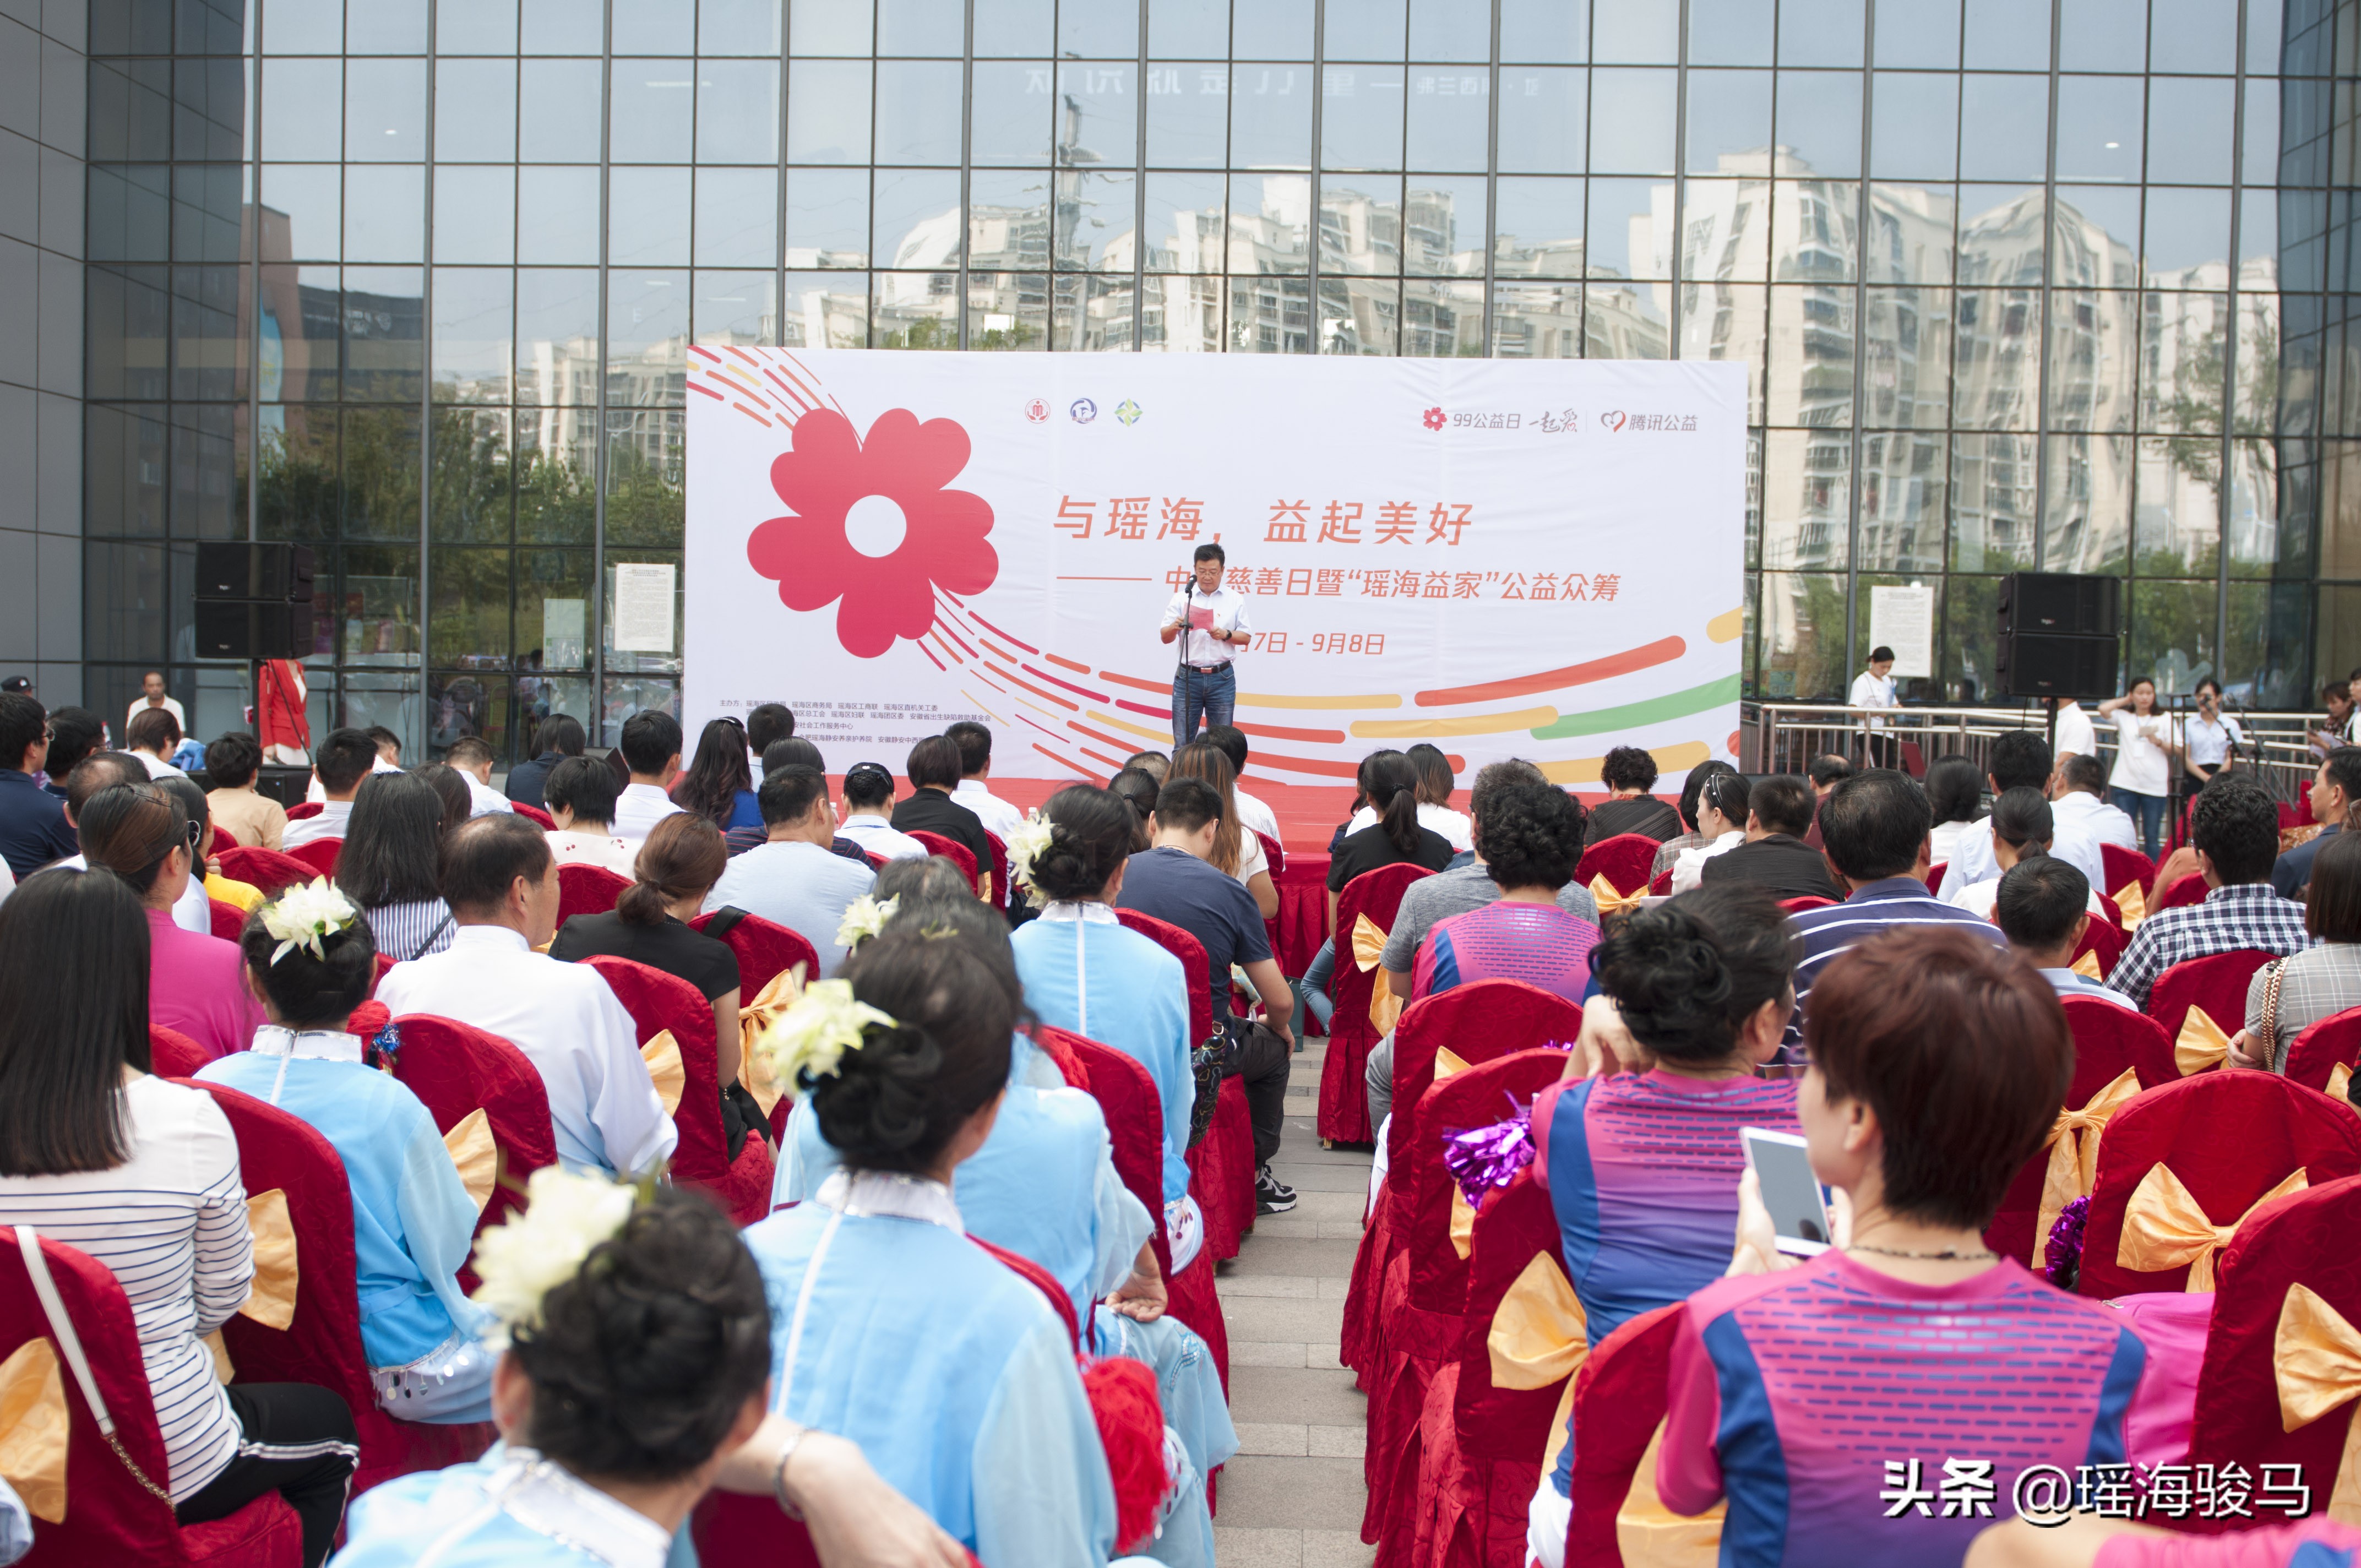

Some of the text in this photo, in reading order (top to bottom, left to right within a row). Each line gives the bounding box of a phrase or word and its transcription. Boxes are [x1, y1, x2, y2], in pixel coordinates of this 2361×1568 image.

[1454, 413, 1521, 429] 99公益日
[1629, 414, 1699, 431] 腾讯公益
[1165, 565, 1620, 601] 中慈善日暨“瑶海益家”公益众筹
[1312, 633, 1385, 655] 9月8日
[795, 721, 853, 730] 安社会工作服务中心
[910, 713, 991, 722] 安徽省出生缺陷救助基金会
